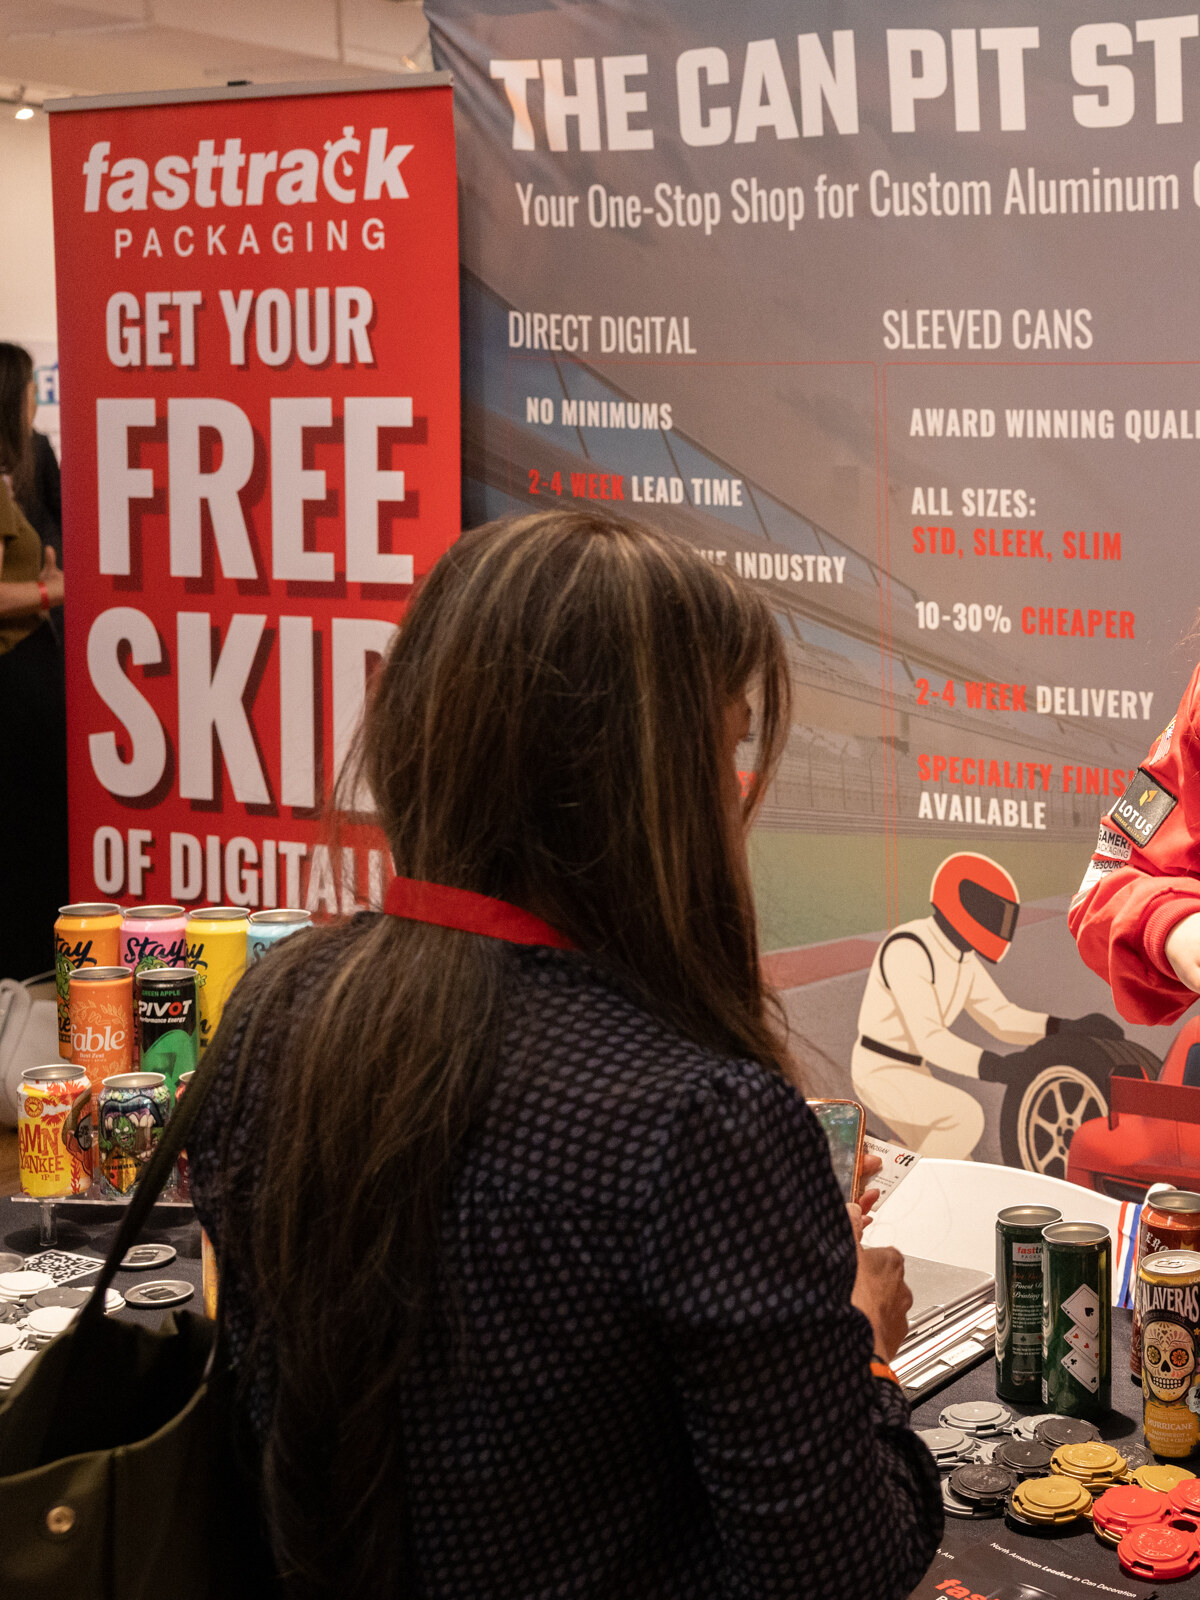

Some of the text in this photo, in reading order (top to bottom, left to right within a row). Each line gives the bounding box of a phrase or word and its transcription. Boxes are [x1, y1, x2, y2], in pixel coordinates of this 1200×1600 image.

[490, 54, 654, 152] THE
[676, 30, 859, 148] CAN
[886, 27, 1039, 132] PIT
[83, 126, 414, 213] fasttrack
[515, 182, 579, 228] Your
[588, 183, 721, 235] One-Stop
[731, 177, 804, 231] Shop
[815, 174, 859, 219] for
[870, 169, 992, 217] Custom
[1003, 167, 1180, 215] Aluminum
[114, 218, 386, 259] PACKAGING
[105, 286, 374, 367] GET YOUR
[509, 310, 697, 354] DIRECT DIGITAL
[883, 308, 1093, 350] SLEEVED CANS
[526, 397, 673, 430] NO MINIMUMS
[910, 408, 996, 437] AWARD
[1005, 409, 1114, 438] WINNING
[96, 396, 414, 585] FREE
[528, 469, 743, 506] 2-4 WEEK LEAD TIME
[911, 487, 1036, 518] ALL SIZES:
[912, 526, 1121, 562] STD, SLEEK, SLIM
[735, 551, 846, 584] INDUSTRY
[916, 600, 1135, 639] 10-30% CHEAPER
[916, 678, 1154, 720] 2-4 WEEK DELIVERY
[917, 754, 1134, 798] SPECIALITY FINIS
[918, 791, 1046, 830] AVAILABLE
[1118, 799, 1153, 836] LOTUS
[92, 826, 152, 895] OF
[54, 933, 98, 969] tay
[124, 936, 187, 968] Stay
[138, 1000, 193, 1017] PIVOT
[71, 1024, 125, 1052] fable
[19, 1147, 65, 1174] YANKEE
[1147, 1418, 1193, 1430] HURRICANE
[990, 1541, 1010, 1556] North
[1008, 1550, 1043, 1570] American
[1041, 1565, 1073, 1581] Leaders
[1080, 1577, 1098, 1588] Can
[1096, 1582, 1137, 1599] Decoration
